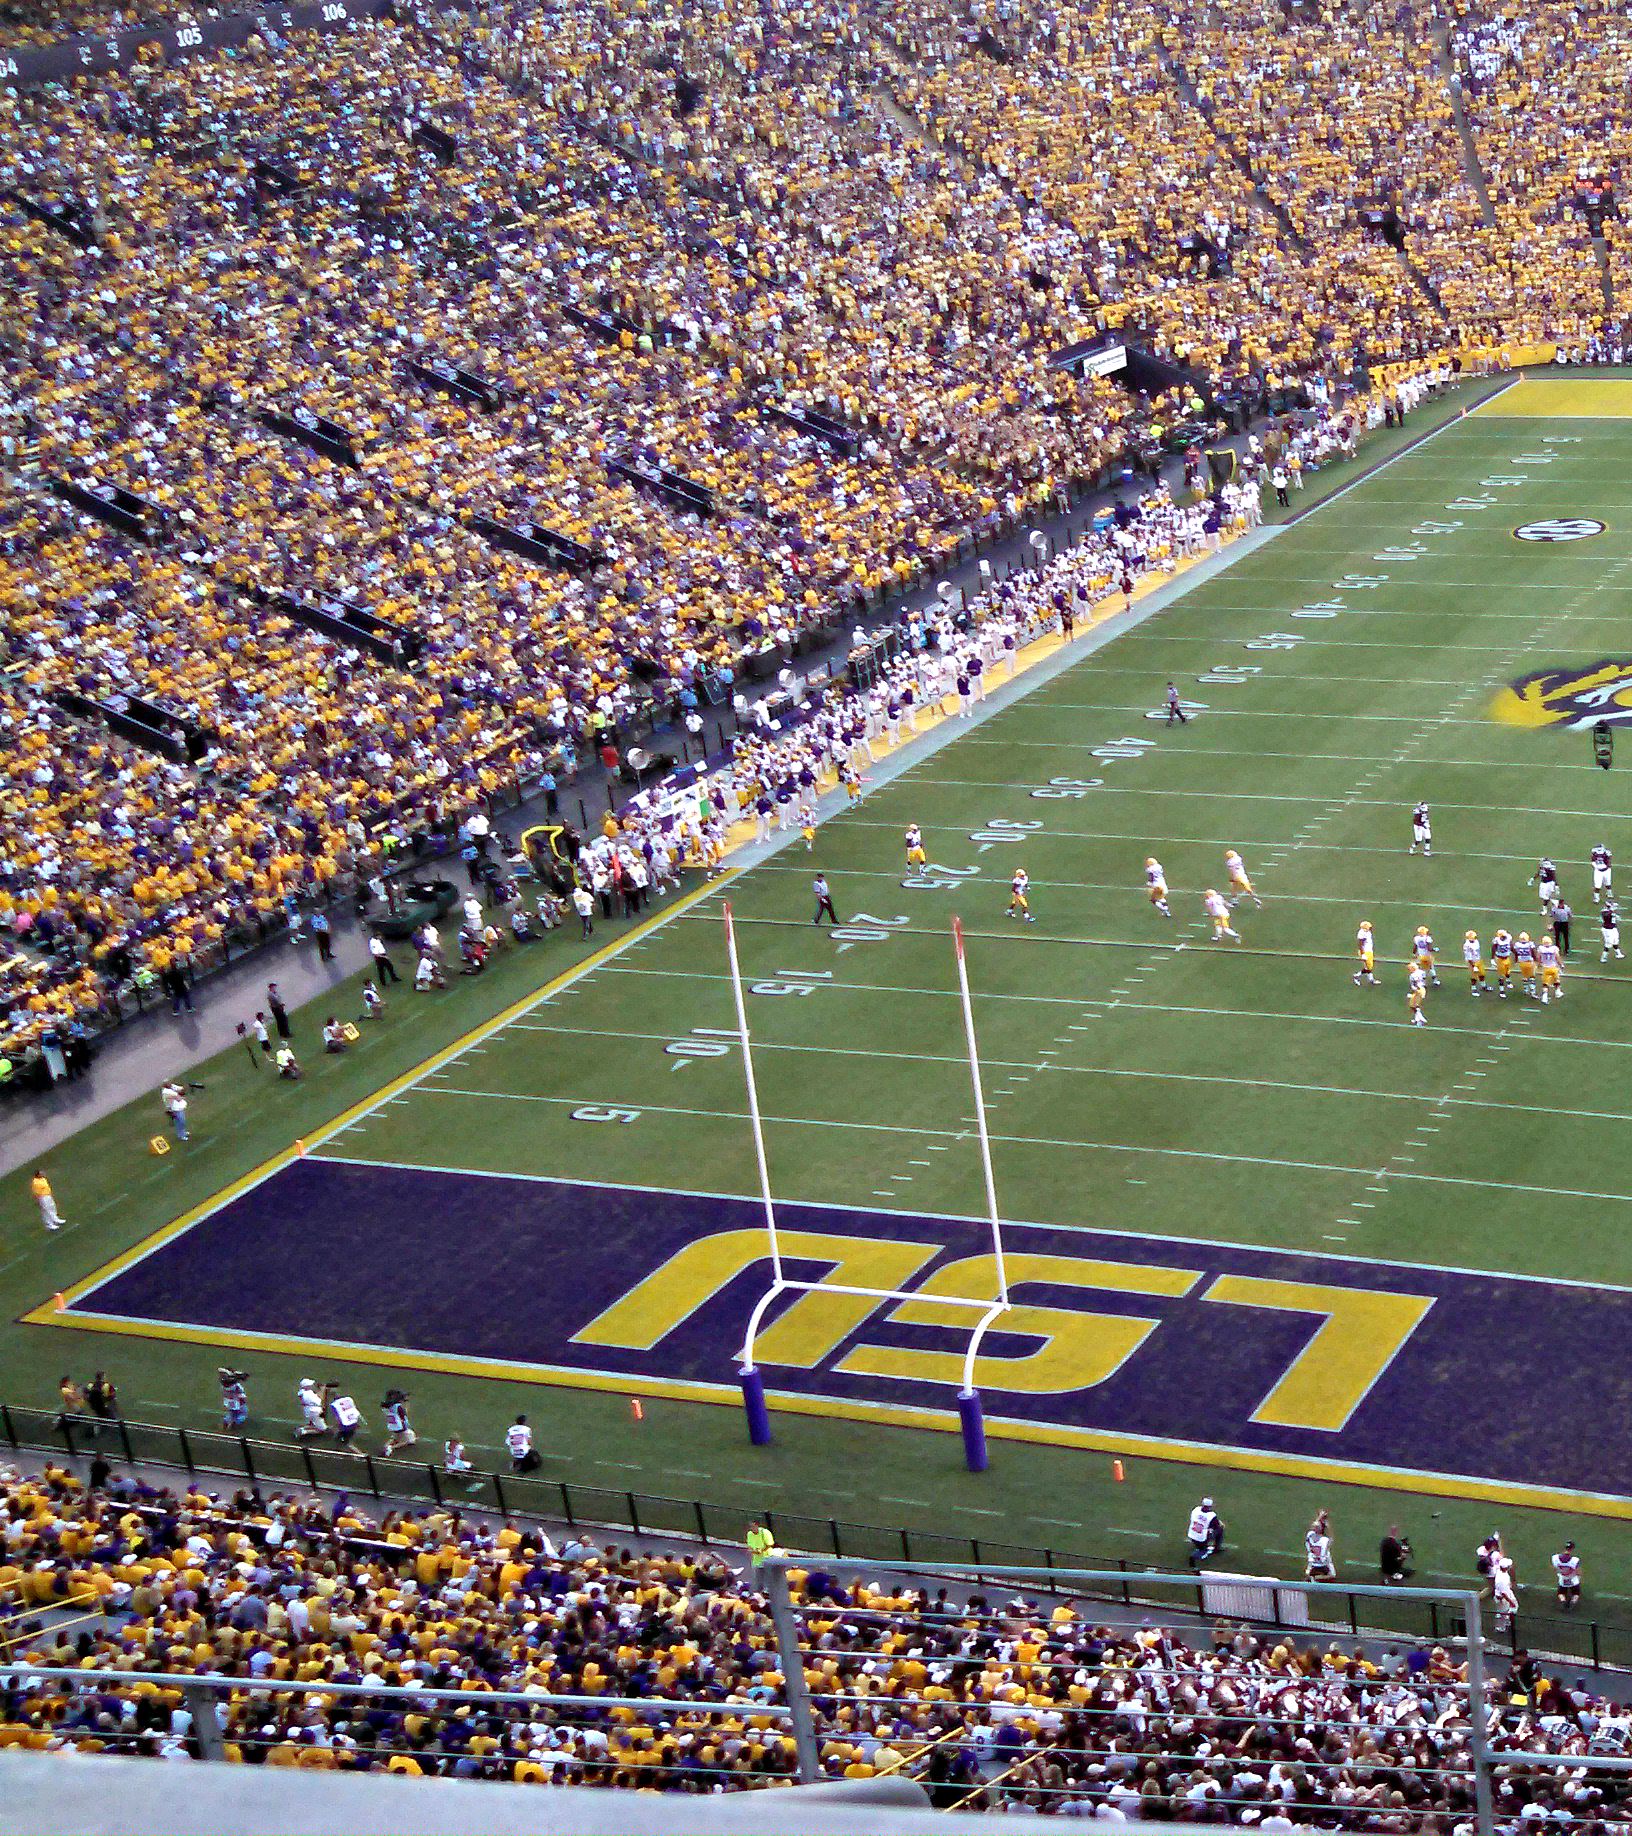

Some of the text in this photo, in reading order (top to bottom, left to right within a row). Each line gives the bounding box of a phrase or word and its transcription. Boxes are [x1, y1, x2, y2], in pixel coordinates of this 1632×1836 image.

[321, 4, 347, 22] 106
[176, 29, 203, 48] 105
[1444, 497, 1498, 510] 20
[1410, 521, 1464, 534] 25
[1516, 519, 1604, 541] SEC
[1372, 545, 1428, 560] 30
[1331, 574, 1389, 589] 35
[1289, 602, 1348, 618] 40
[1242, 632, 1305, 650] 45
[1197, 665, 1262, 684] 50
[1089, 737, 1157, 758] 40
[1029, 776, 1104, 799] 35
[969, 818, 1045, 842] 30
[900, 863, 981, 889] 25
[829, 913, 911, 941] 20
[748, 970, 833, 996] 15
[664, 1028, 750, 1056] 10
[570, 1106, 642, 1124] 5
[566, 1226, 1440, 1434] LSU
